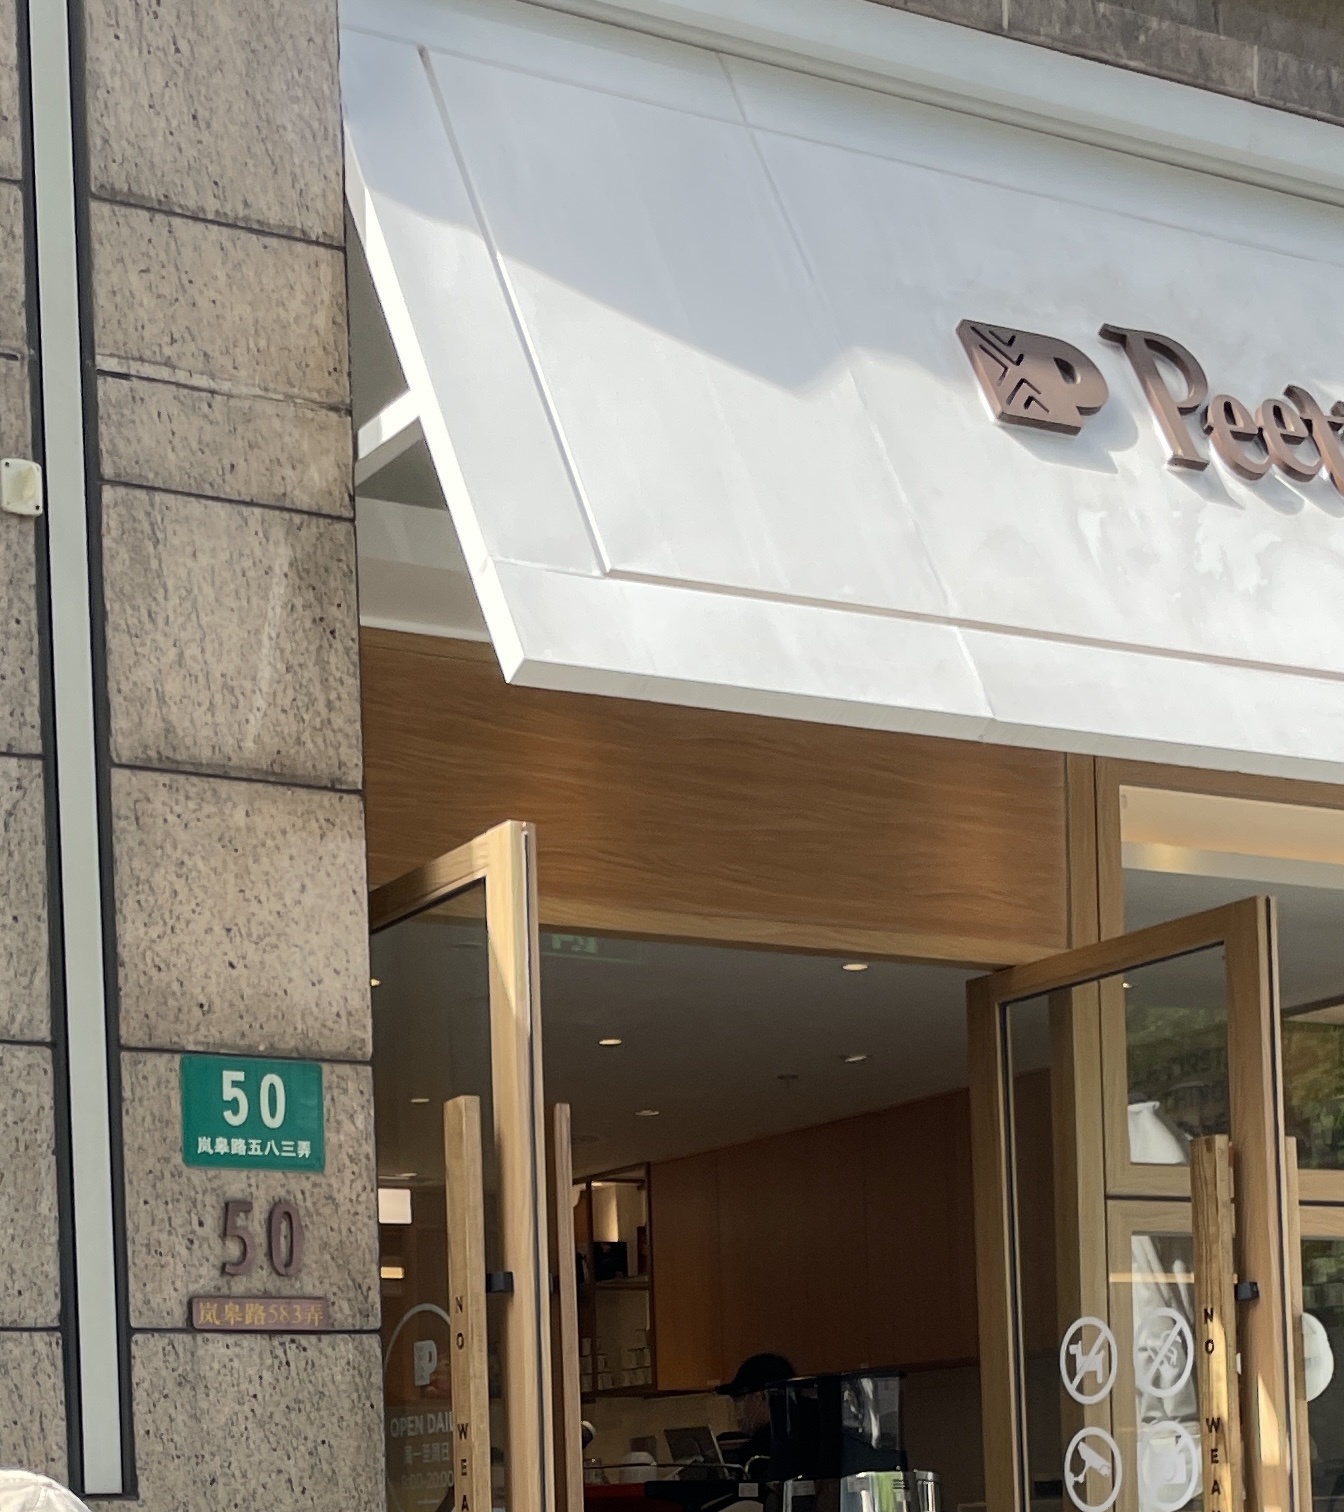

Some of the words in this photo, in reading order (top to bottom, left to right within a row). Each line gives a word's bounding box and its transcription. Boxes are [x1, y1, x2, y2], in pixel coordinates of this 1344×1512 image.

[222, 1070, 286, 1129] 50
[197, 1135, 311, 1158] 岚皋路五八三弄
[221, 1200, 304, 1277] 50
[199, 1301, 323, 1326] 岚皋路583弄
[454, 1296, 464, 1351] NO
[1203, 1307, 1215, 1355] NO
[390, 1414, 424, 1438] OPEN
[427, 1411, 454, 1434] DAIL
